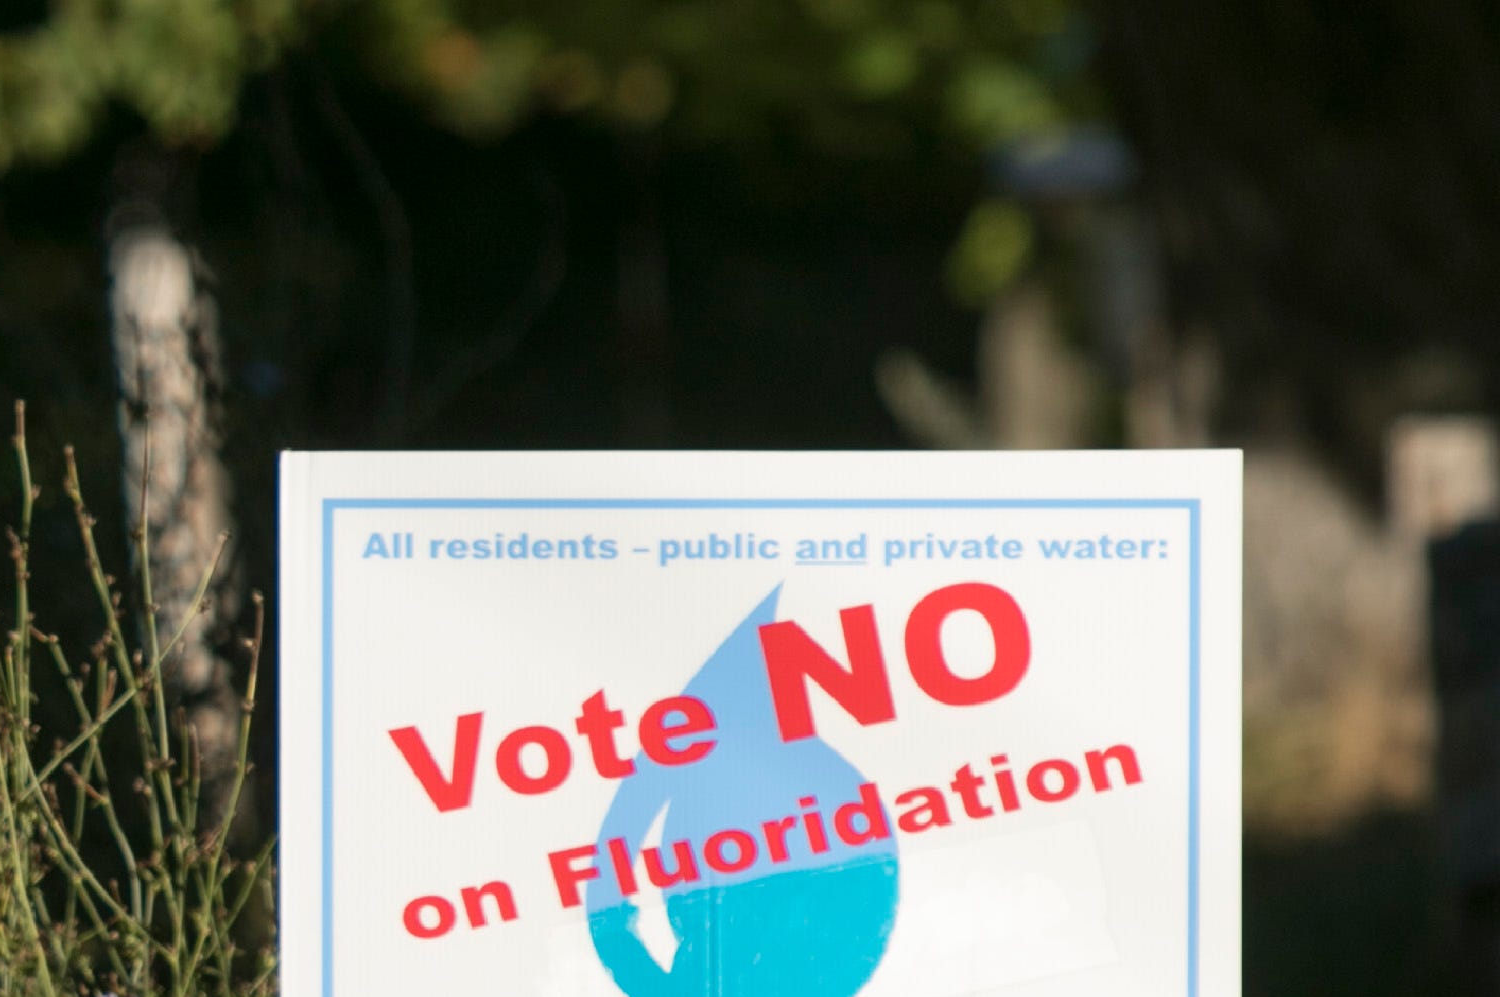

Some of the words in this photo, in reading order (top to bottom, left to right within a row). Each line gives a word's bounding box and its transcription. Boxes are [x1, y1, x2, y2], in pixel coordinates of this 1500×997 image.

[361, 532, 414, 560] All
[428, 532, 619, 561] residents
[658, 532, 779, 567] public
[795, 532, 867, 561] and
[883, 532, 1023, 567] private
[1038, 534, 1169, 561] water:
[388, 689, 717, 813] Vote
[757, 581, 1033, 743] NO
[402, 880, 518, 939] on
[547, 744, 1142, 908] Fluoridation
